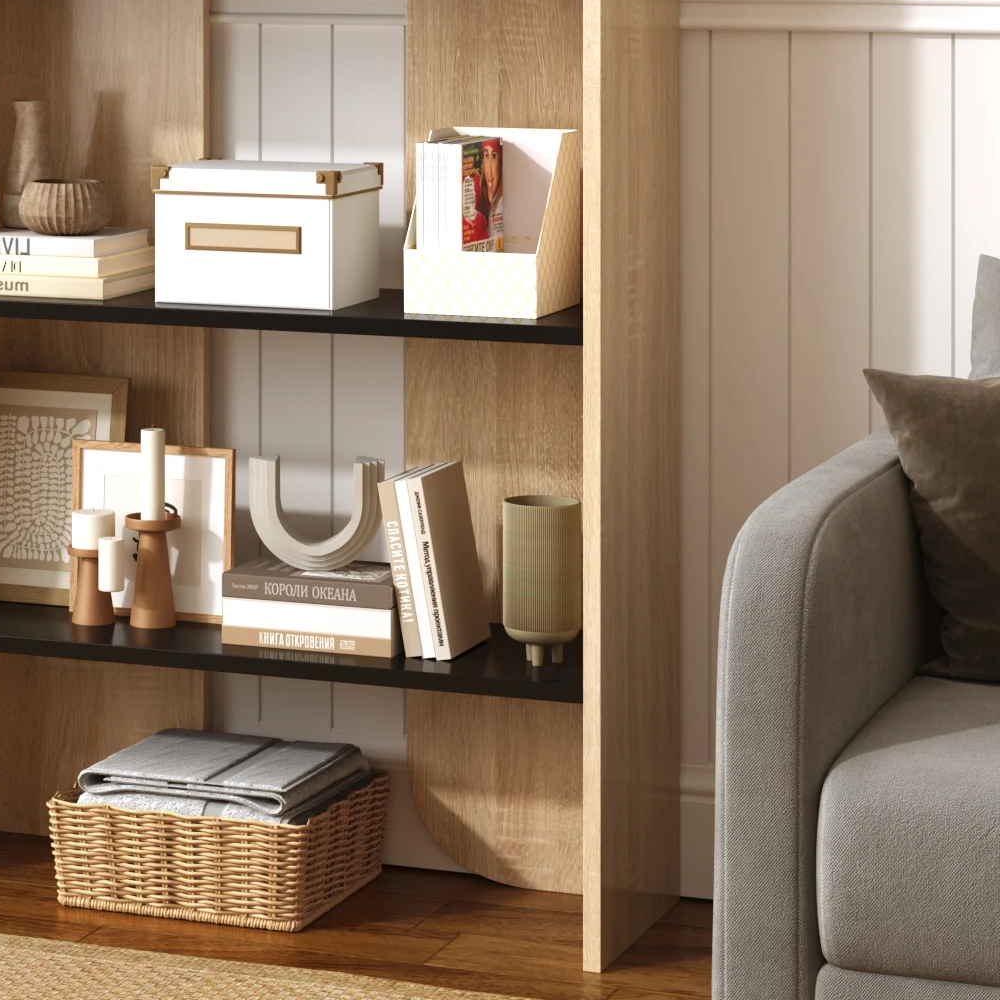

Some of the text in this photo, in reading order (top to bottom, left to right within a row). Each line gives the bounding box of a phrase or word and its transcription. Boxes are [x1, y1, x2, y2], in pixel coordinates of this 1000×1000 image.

[264, 581, 309, 599] КОРОЛИ
[311, 585, 357, 602] ОКЕАНА
[386, 520, 414, 623] СПАСИТЕ КОТИКА!
[422, 541, 431, 564] Метод
[433, 608, 445, 647] проектами
[258, 631, 285, 647] КНИГА
[285, 633, 335, 651] ОТКРОВЕНИЯ
